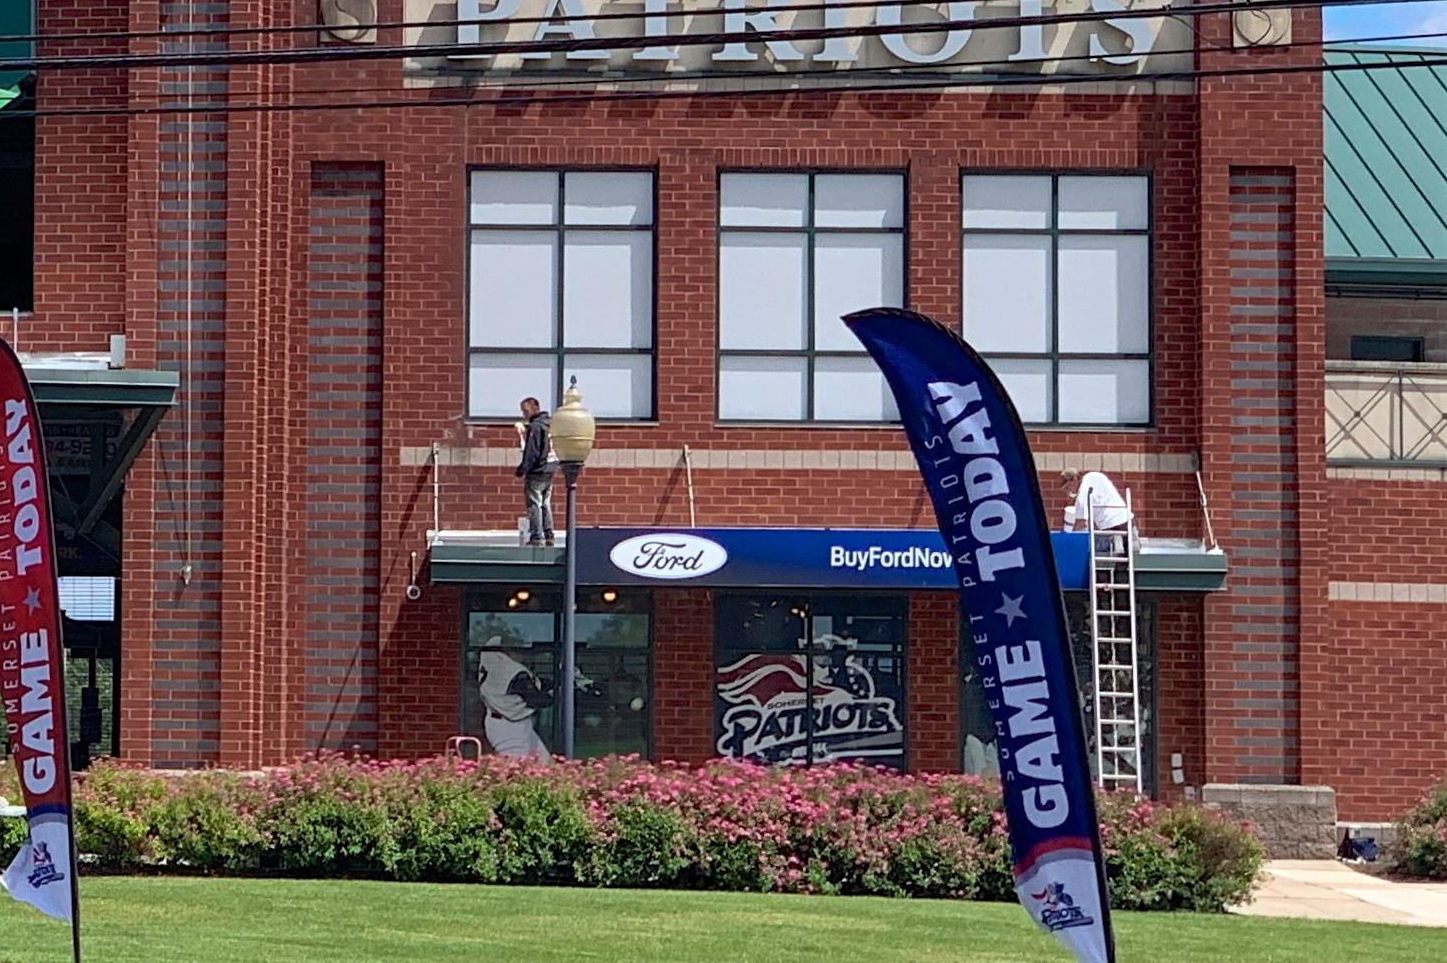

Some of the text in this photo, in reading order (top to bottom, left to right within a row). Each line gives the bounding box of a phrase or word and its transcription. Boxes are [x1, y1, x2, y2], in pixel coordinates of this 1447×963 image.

[633, 541, 704, 572] Ford
[924, 435, 977, 587] PATRIOTS
[5, 398, 56, 794] GAME TODAY
[927, 381, 1069, 828] GAME TODAY
[1, 604, 20, 754] SOMERSET
[767, 697, 825, 710] SOMERET
